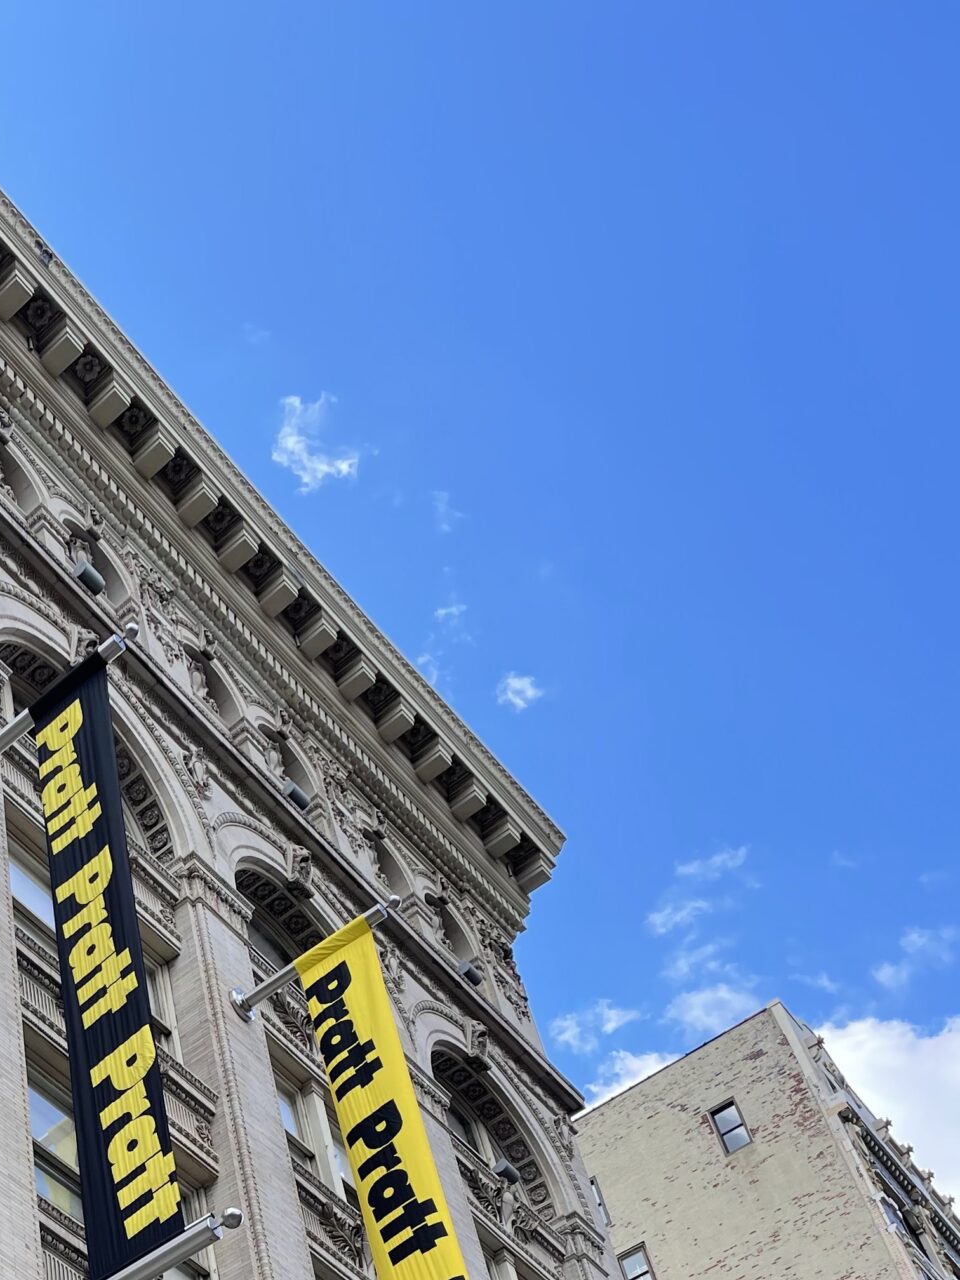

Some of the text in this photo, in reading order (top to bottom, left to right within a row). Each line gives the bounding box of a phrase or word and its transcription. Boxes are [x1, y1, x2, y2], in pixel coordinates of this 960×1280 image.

[36, 698, 184, 1239] Pratt Pratt Pratt
[305, 961, 383, 1102] Pratt
[347, 1098, 447, 1267] Pratt
